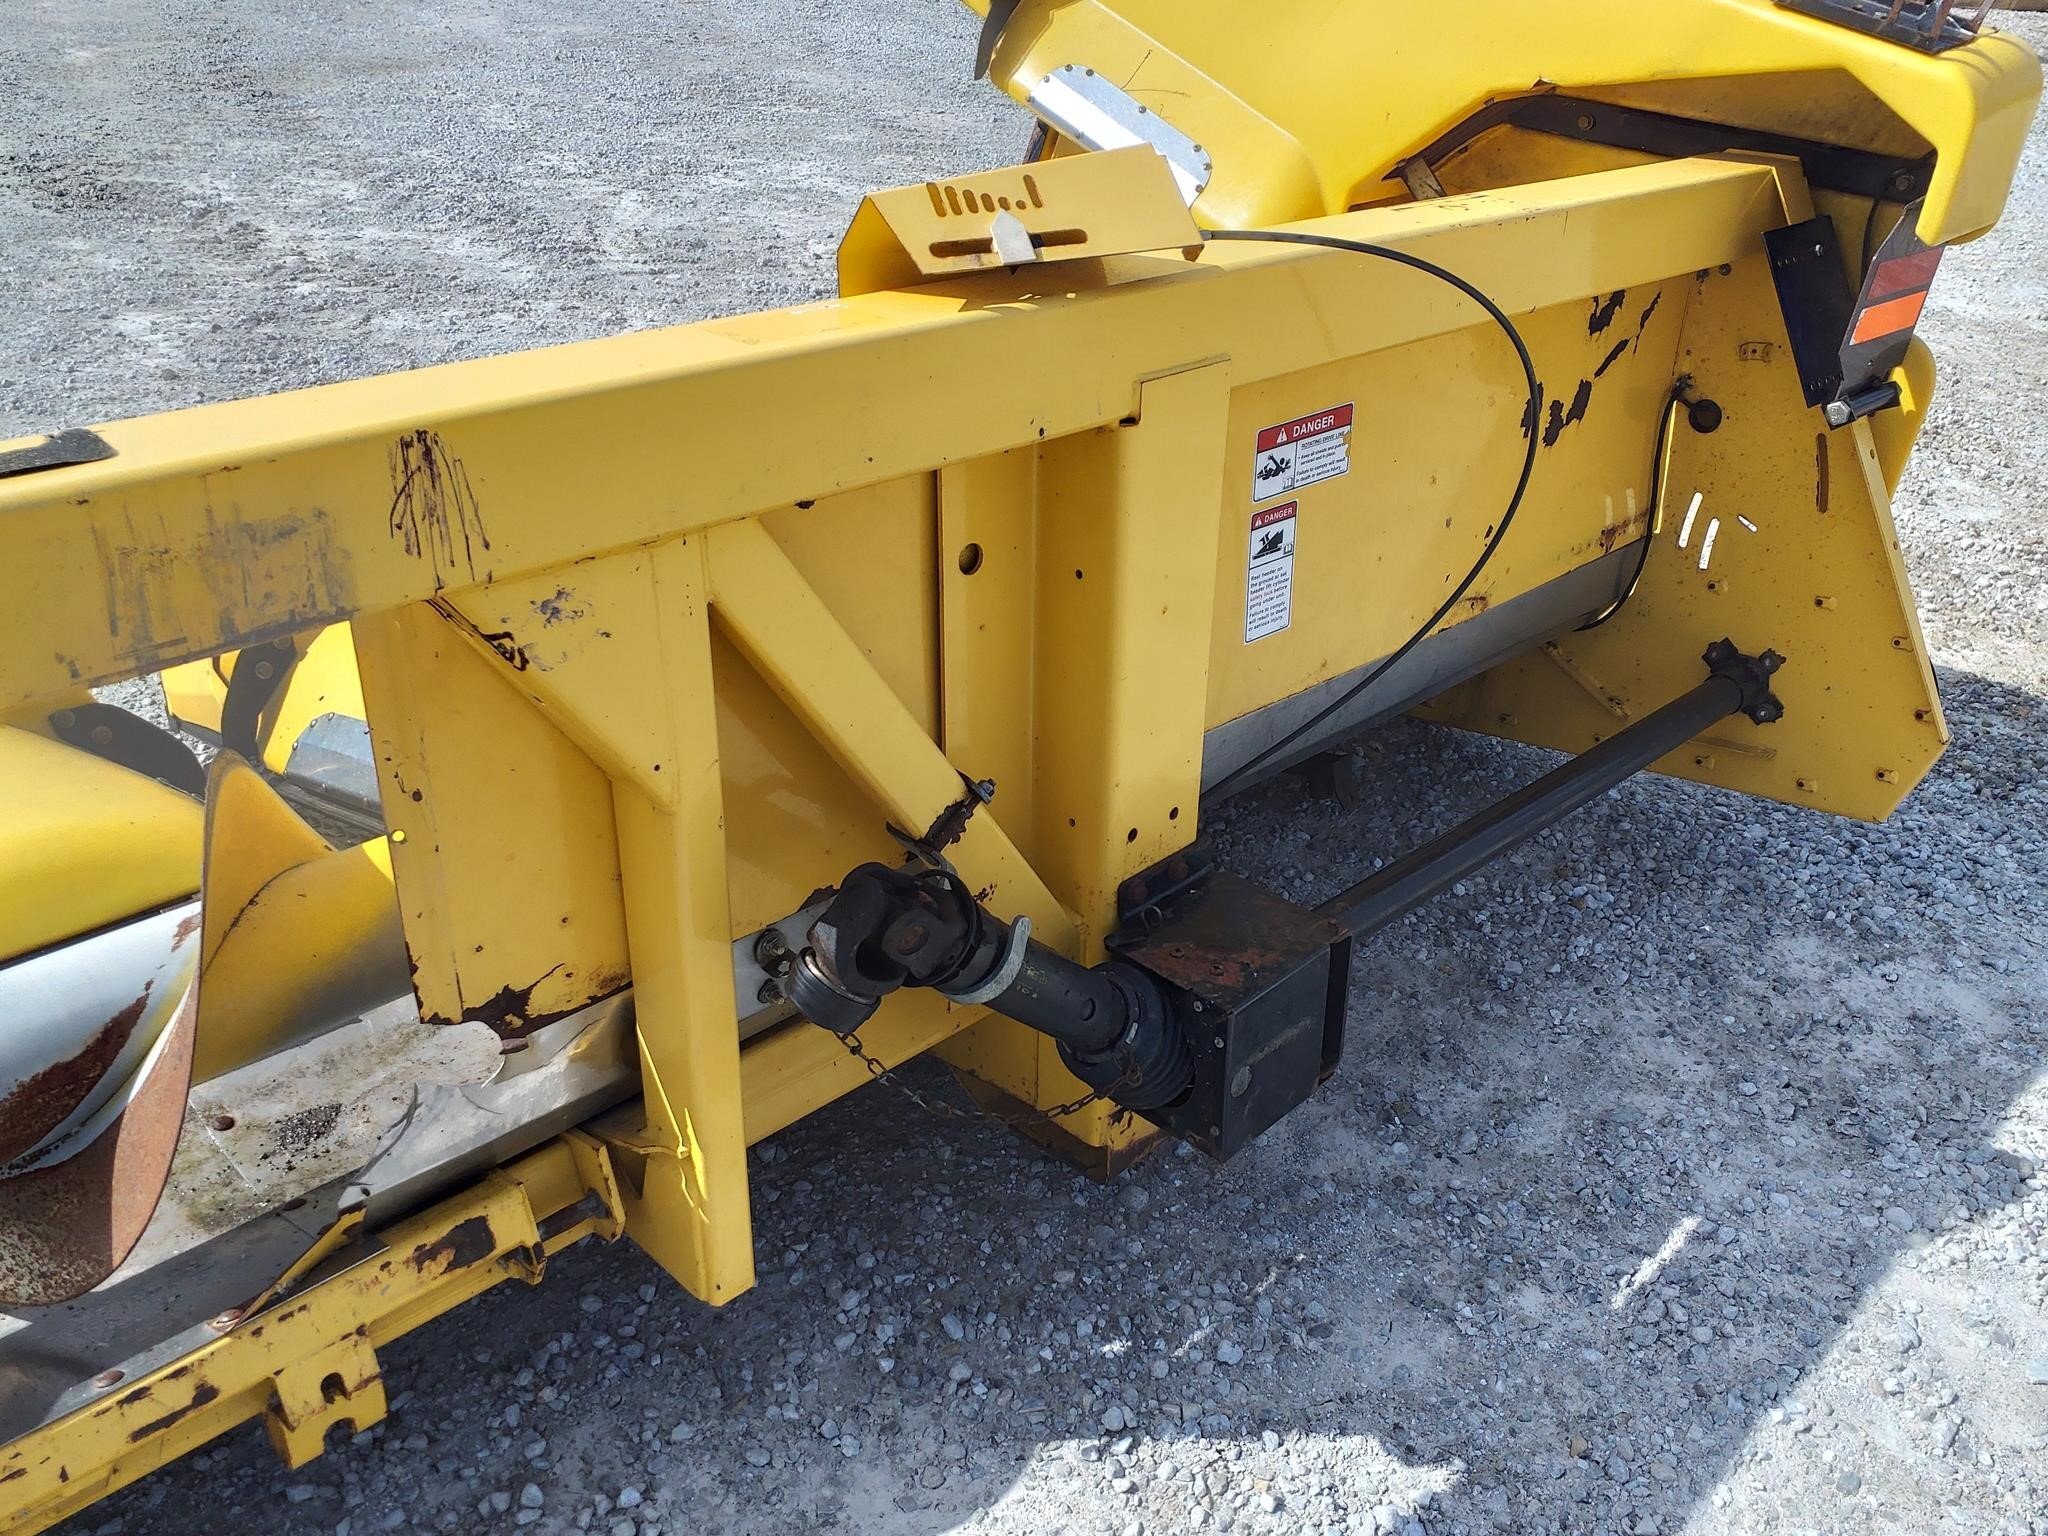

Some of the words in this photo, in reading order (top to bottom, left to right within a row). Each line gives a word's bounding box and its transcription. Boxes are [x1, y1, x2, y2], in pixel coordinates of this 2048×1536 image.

[1293, 415, 1334, 437] DANGER
[1301, 438, 1321, 448] ROTATING
[1264, 507, 1292, 522] DANGER
[1262, 568, 1276, 576] header
[1250, 587, 1264, 595] header
[1273, 577, 1289, 586] cylinder
[1258, 576, 1273, 585] ground
